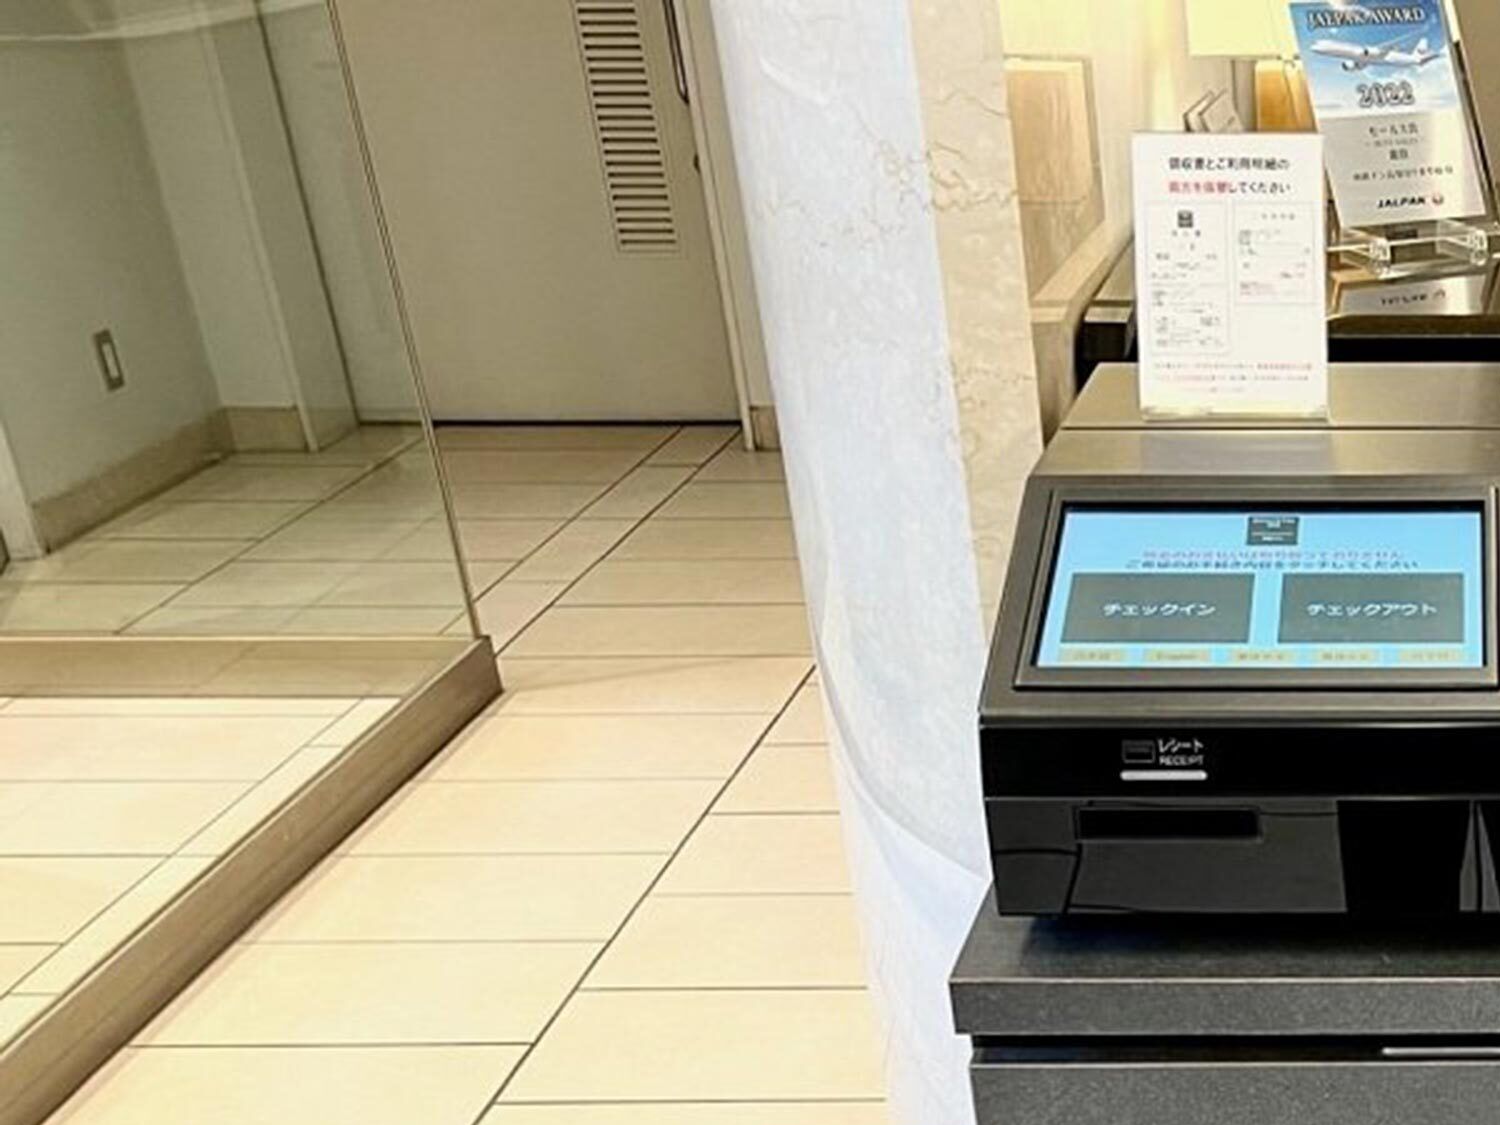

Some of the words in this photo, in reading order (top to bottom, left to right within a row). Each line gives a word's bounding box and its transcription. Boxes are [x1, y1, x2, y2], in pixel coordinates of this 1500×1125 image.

[1368, 6, 1427, 26] AWARD
[1356, 80, 1416, 109] 2022
[1102, 602, 1216, 617] チェックイン
[1306, 602, 1438, 617] チェックアウト
[1158, 738, 1204, 753] レシート
[1159, 754, 1204, 766] RECEIPT
